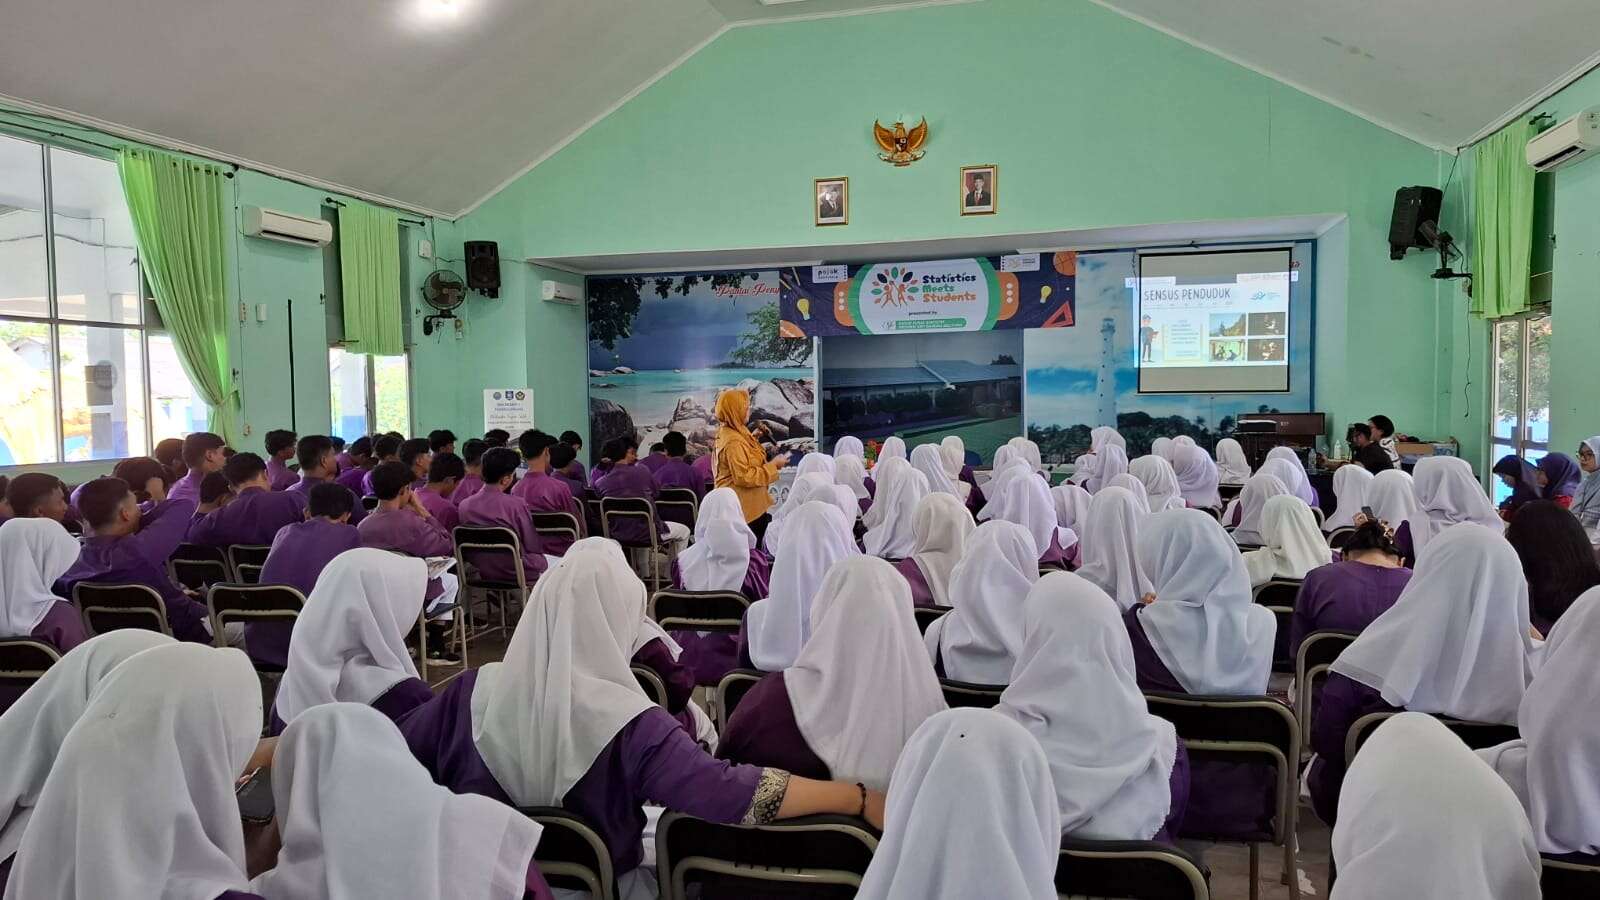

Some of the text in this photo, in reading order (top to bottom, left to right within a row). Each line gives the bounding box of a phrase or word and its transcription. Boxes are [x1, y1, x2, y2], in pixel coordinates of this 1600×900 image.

[923, 272, 976, 283] Statistics
[923, 284, 954, 293] Meets
[923, 292, 976, 302] Students
[1143, 287, 1231, 301] SENSUS PENDUDUK
